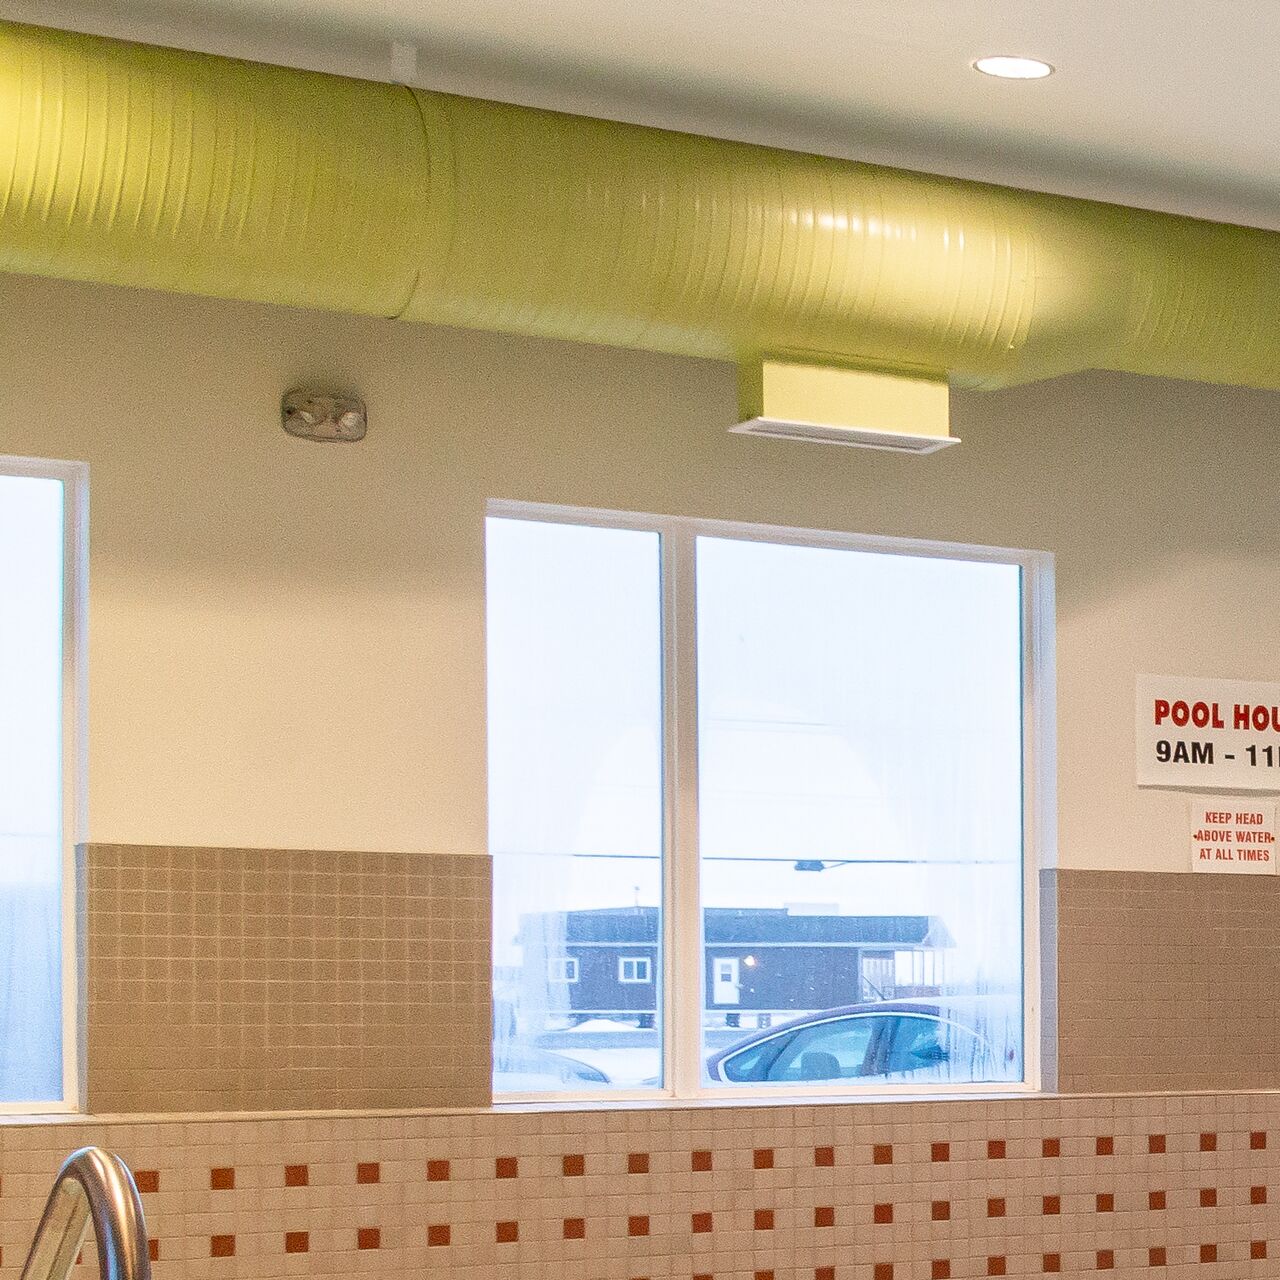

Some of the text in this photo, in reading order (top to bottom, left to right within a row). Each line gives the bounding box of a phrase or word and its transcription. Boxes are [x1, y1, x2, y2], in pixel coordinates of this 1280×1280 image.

[1155, 699, 1223, 729] POOL
[1156, 740, 1214, 764] 9AM
[1205, 812, 1263, 825] KEEP HEAD
[1197, 830, 1271, 843] ABOVE WATER
[1200, 849, 1269, 861] AT ALL TIMES
